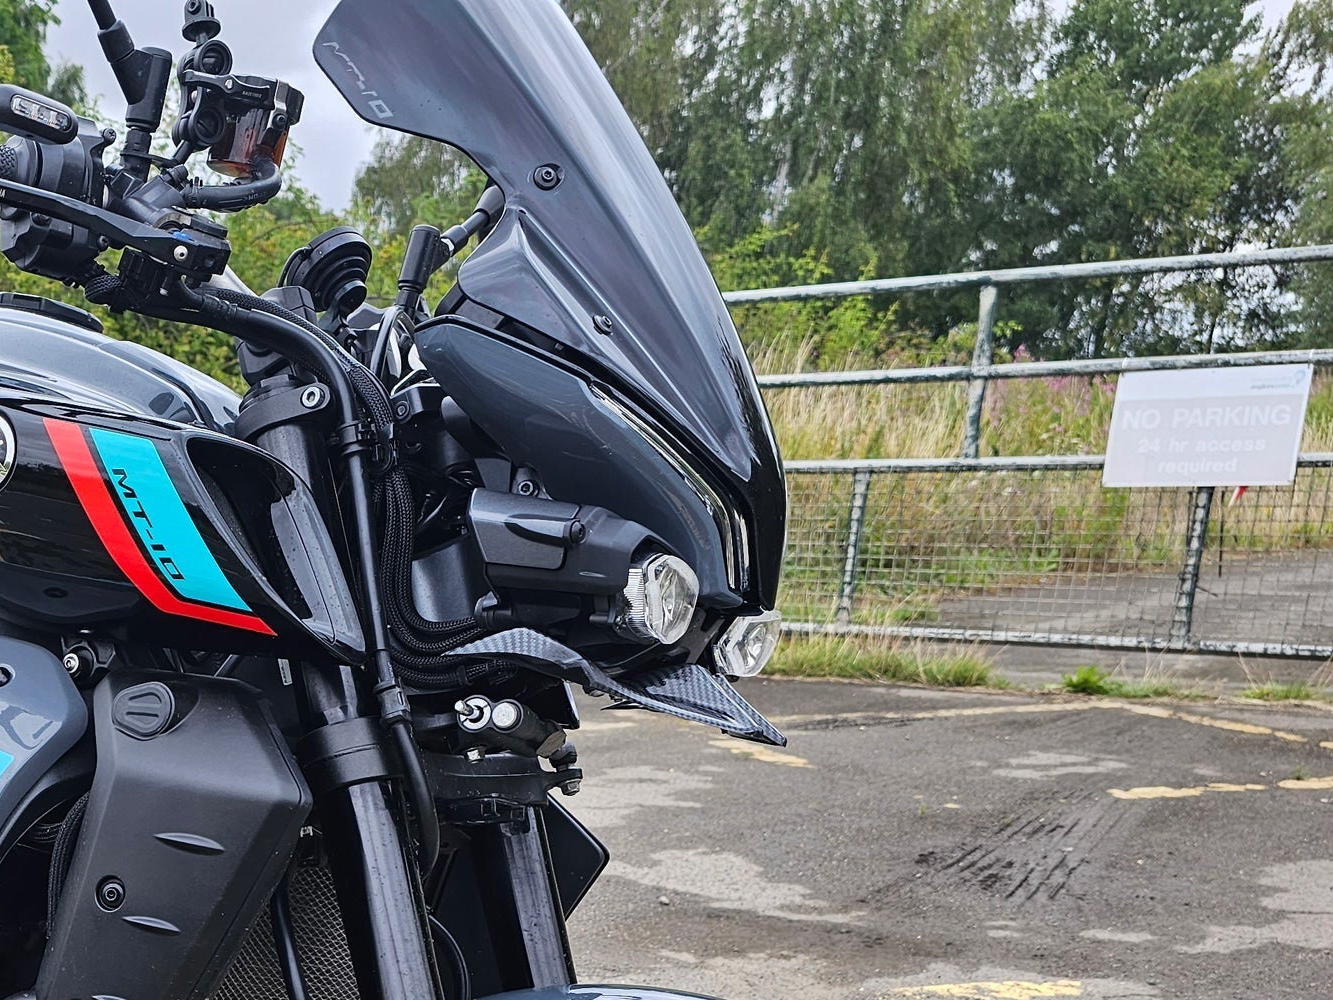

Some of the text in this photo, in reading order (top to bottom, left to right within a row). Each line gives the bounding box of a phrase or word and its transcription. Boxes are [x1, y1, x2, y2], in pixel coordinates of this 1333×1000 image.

[1122, 404, 1292, 430] NO PARKING
[1137, 437, 1266, 454] 24 hr access
[1157, 457, 1238, 475] required
[112, 469, 185, 580] MT-10
